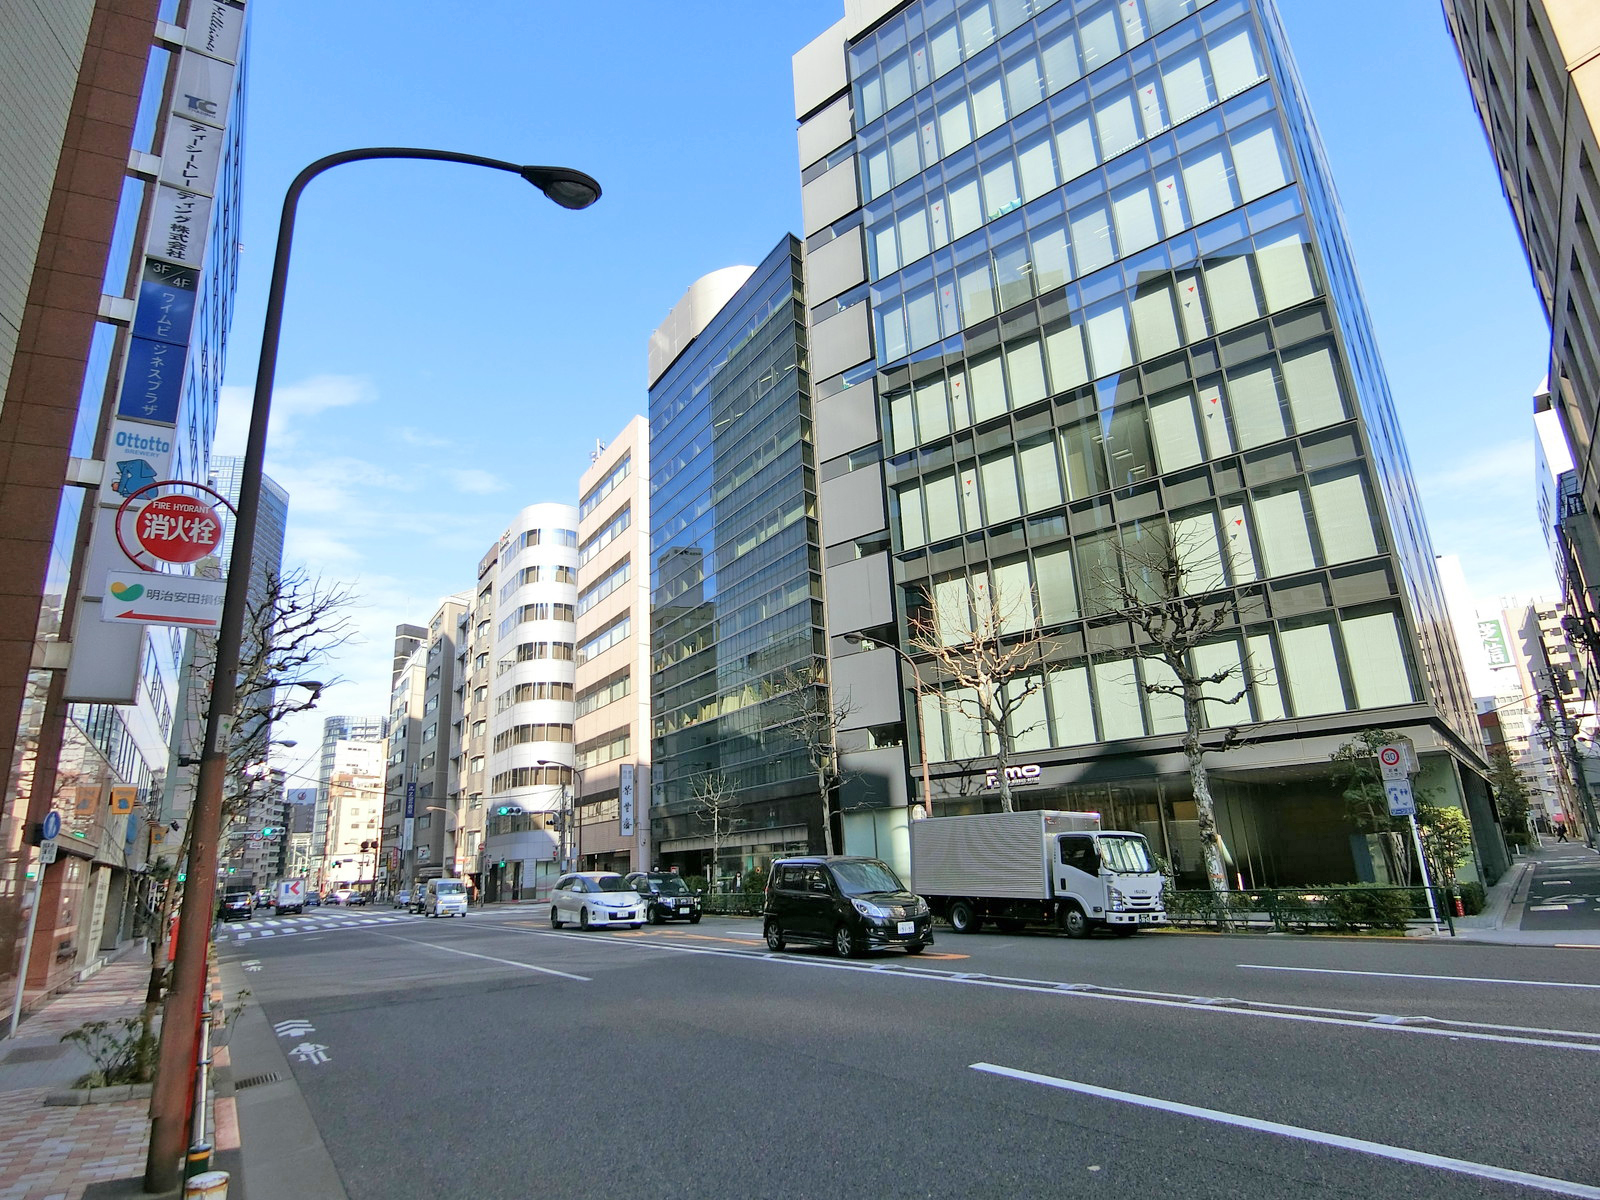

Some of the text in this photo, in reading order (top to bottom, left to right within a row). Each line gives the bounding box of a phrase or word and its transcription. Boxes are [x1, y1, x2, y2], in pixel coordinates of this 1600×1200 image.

[116, 431, 170, 453] Ottotto
[124, 448, 160, 458] BREWERY
[153, 500, 210, 514] FIRE HYDRANT
[143, 512, 217, 545] 消火栓
[1385, 753, 1396, 762] 30
